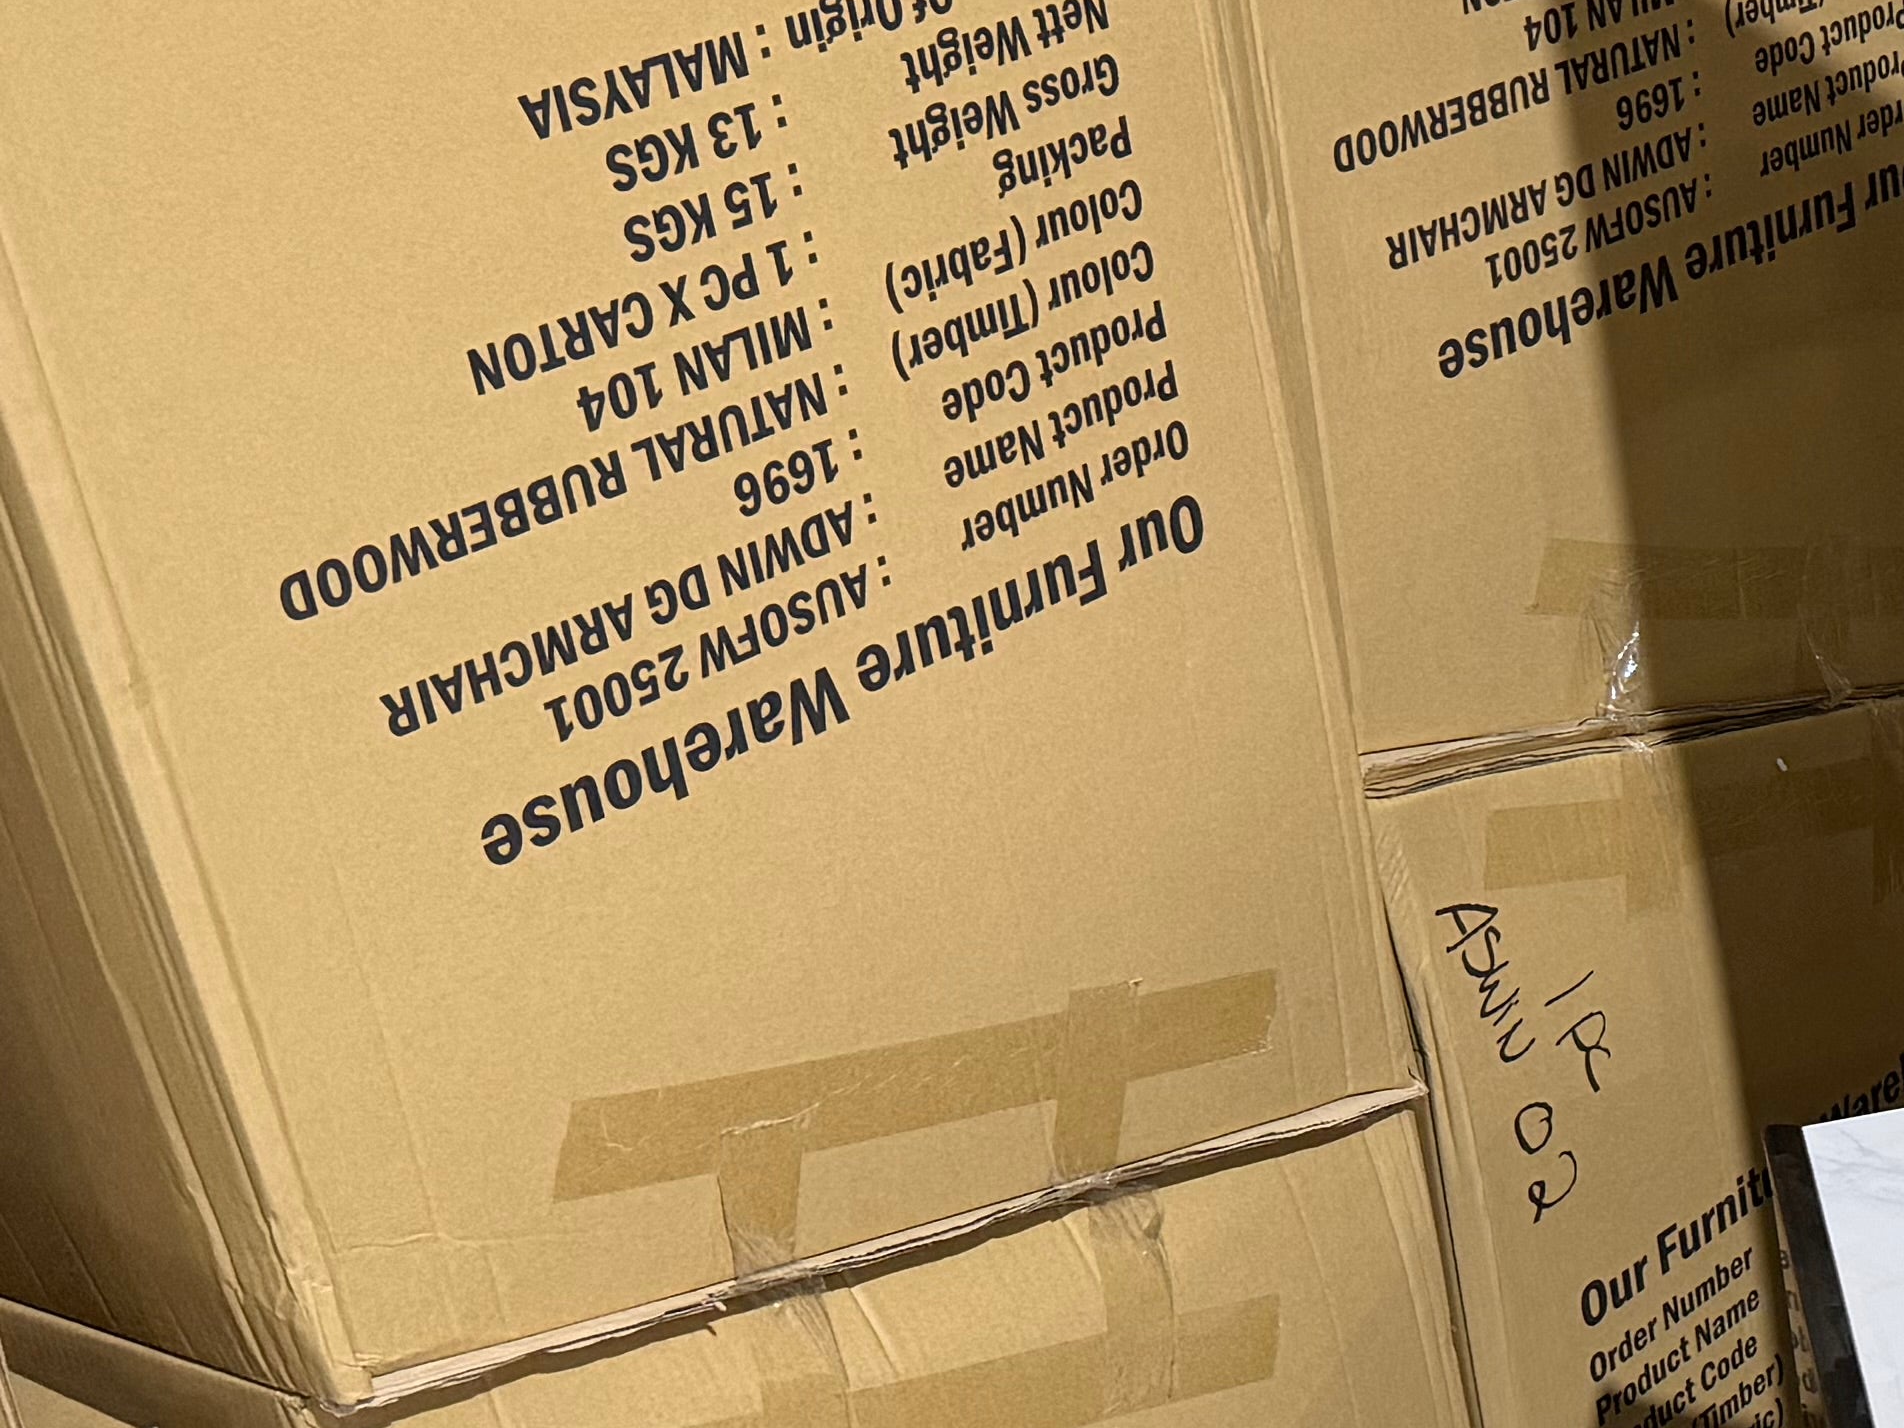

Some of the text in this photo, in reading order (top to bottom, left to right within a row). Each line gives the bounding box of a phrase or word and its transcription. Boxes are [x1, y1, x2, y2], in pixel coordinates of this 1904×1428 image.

[899, 15, 1033, 95] Weight
[1523, 1, 1579, 52] 104
[605, 122, 700, 192] KGS
[1759, 118, 1853, 178] Number
[1047, 240, 1154, 311] Colour
[1484, 223, 1579, 289] 25001
[1684, 180, 1857, 281] Furniture
[891, 278, 1039, 382] (Timber)
[1034, 299, 1168, 389] Product
[1437, 254, 1679, 379] Warehouse
[941, 359, 1031, 424] Code
[1047, 359, 1179, 450] Product
[943, 419, 1045, 488] Name
[1100, 420, 1189, 486] Order
[279, 449, 628, 621] RUBBERWOOD
[961, 462, 1095, 552] Number
[643, 563, 711, 625] DG
[378, 592, 633, 737] ARMCHAIR
[480, 494, 1204, 866] Our Furniture Warehouse
[543, 643, 690, 743] 25001
[1580, 1254, 1648, 1327] Our
[1589, 1246, 1753, 1383] Order Number
[1595, 1289, 1760, 1428] Product Name
